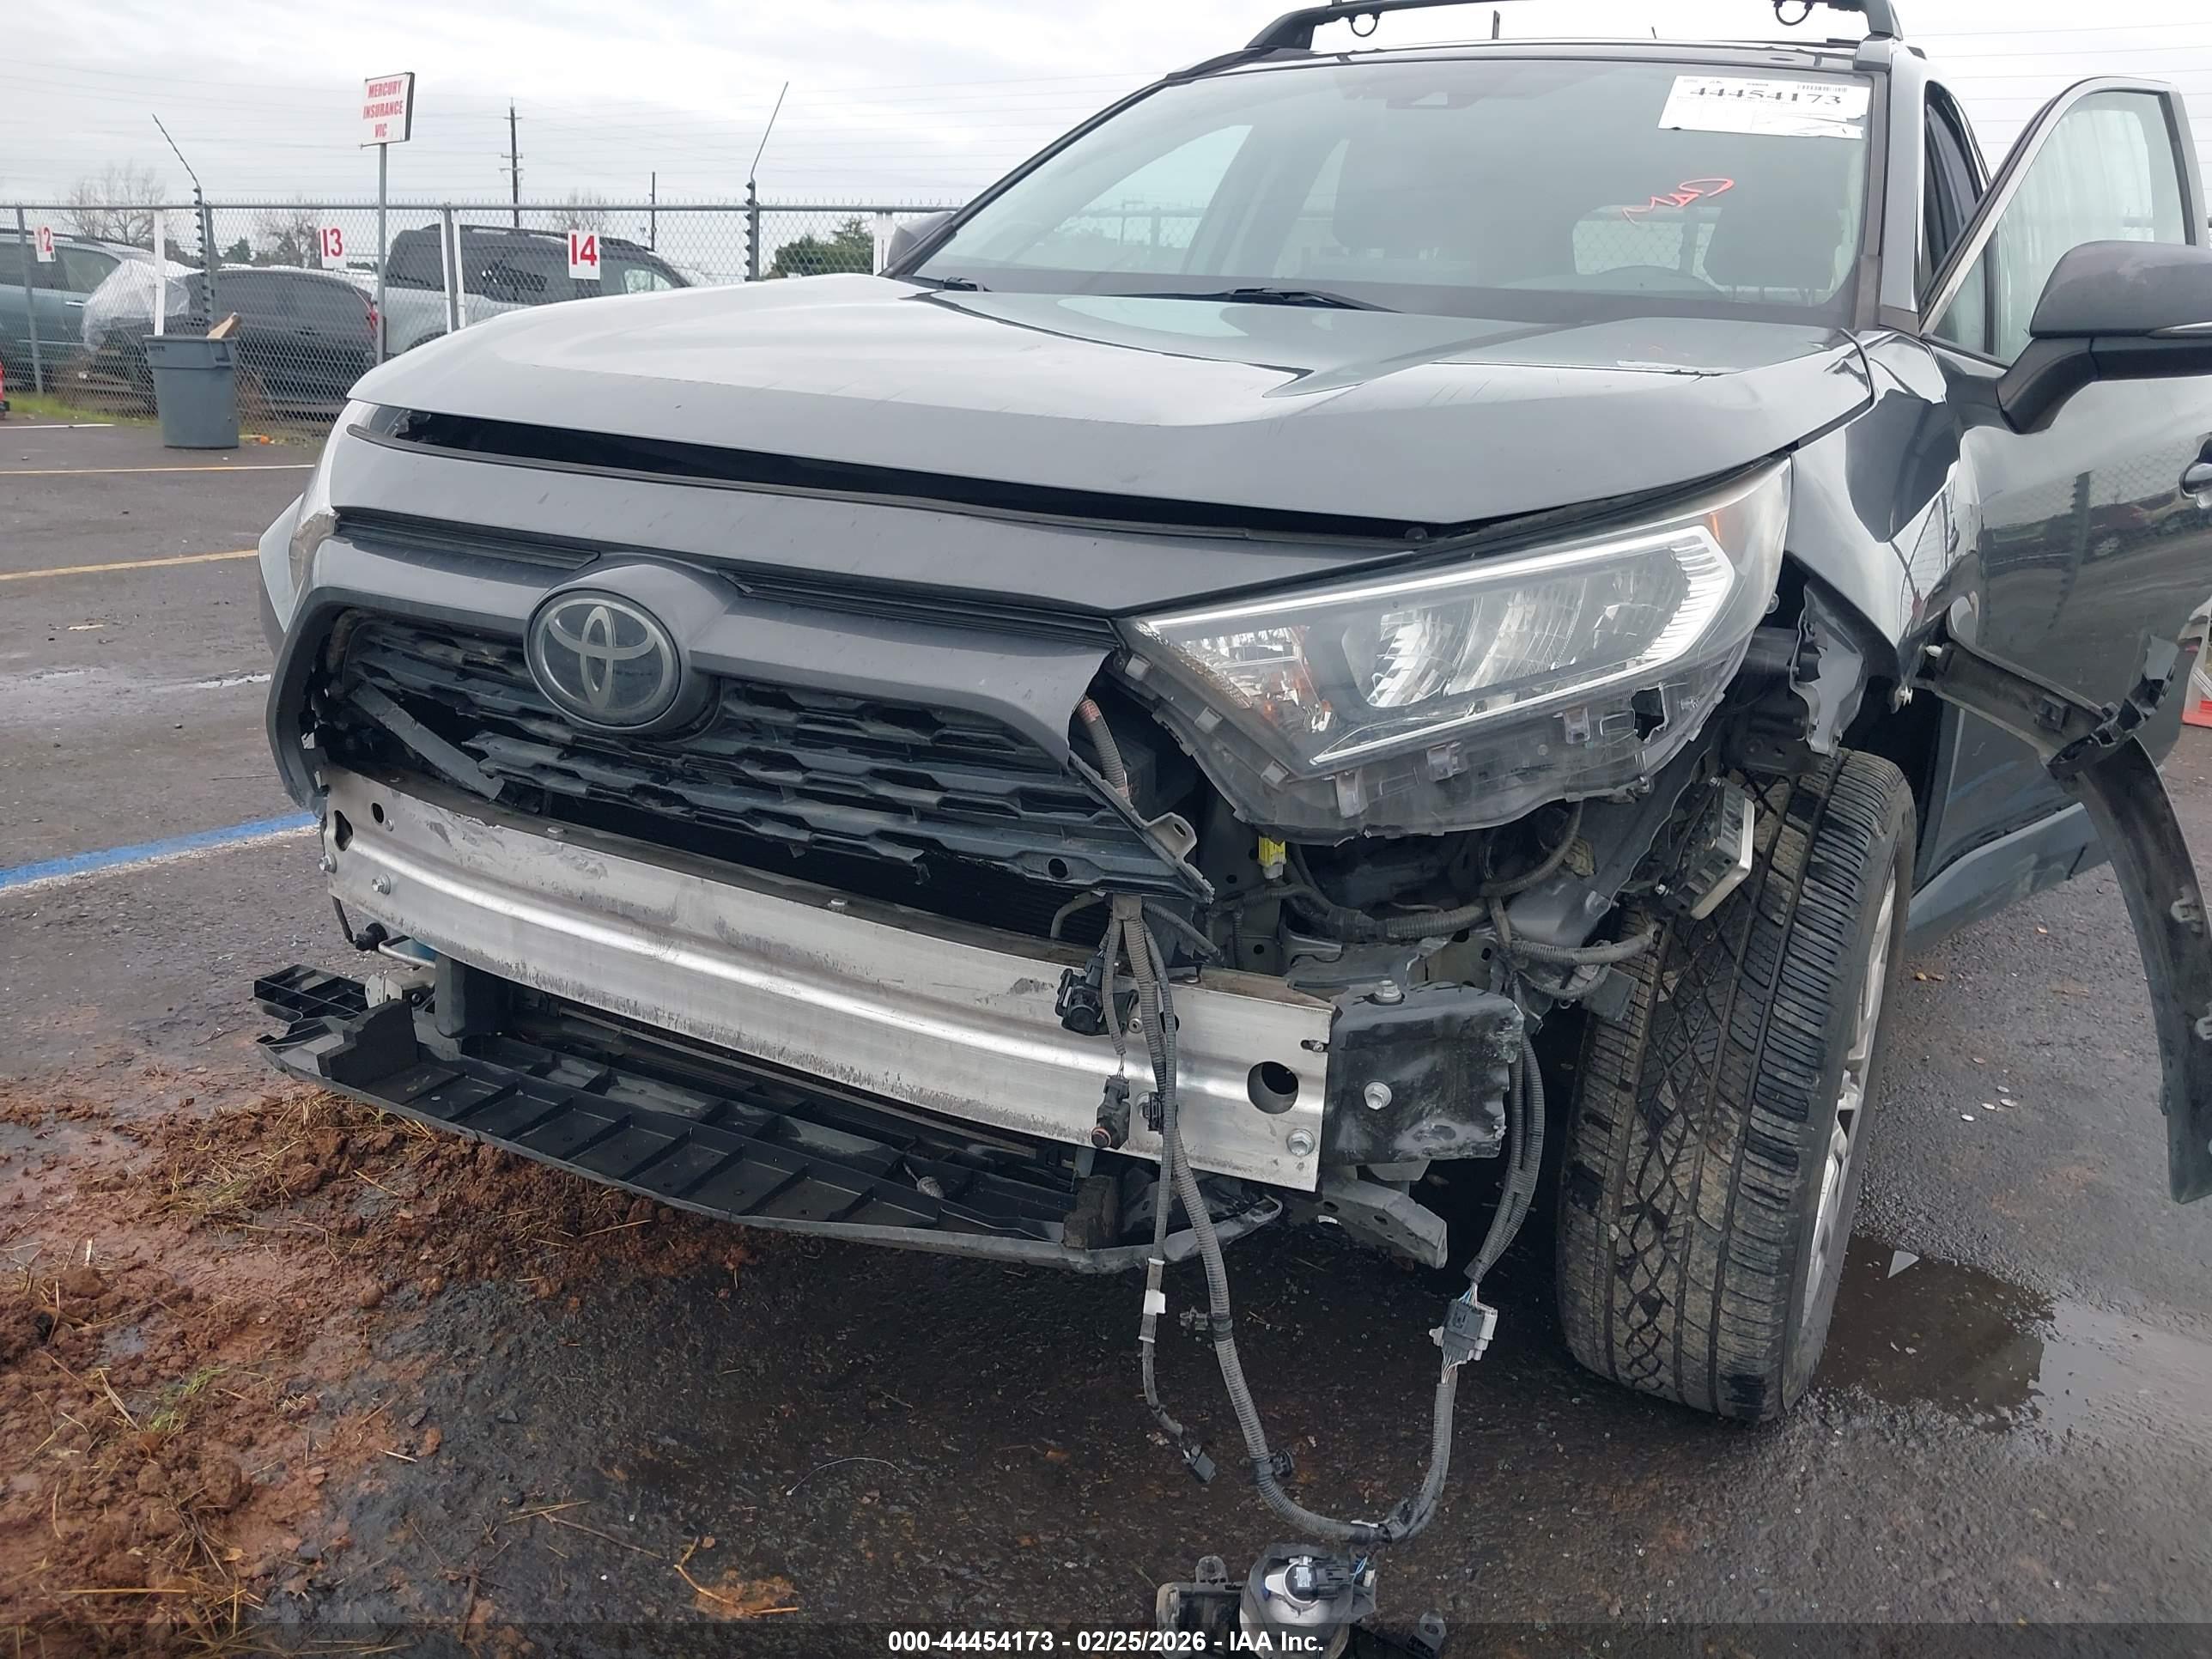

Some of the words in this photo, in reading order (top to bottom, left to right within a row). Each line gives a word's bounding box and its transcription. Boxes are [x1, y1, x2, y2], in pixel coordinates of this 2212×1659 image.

[368, 81, 403, 98] MERCURY
[1690, 88, 1841, 104] 44454173
[363, 100, 403, 119] INSURANCE
[374, 123, 387, 137] VIC
[323, 228, 343, 257] 13
[572, 234, 597, 266] 14
